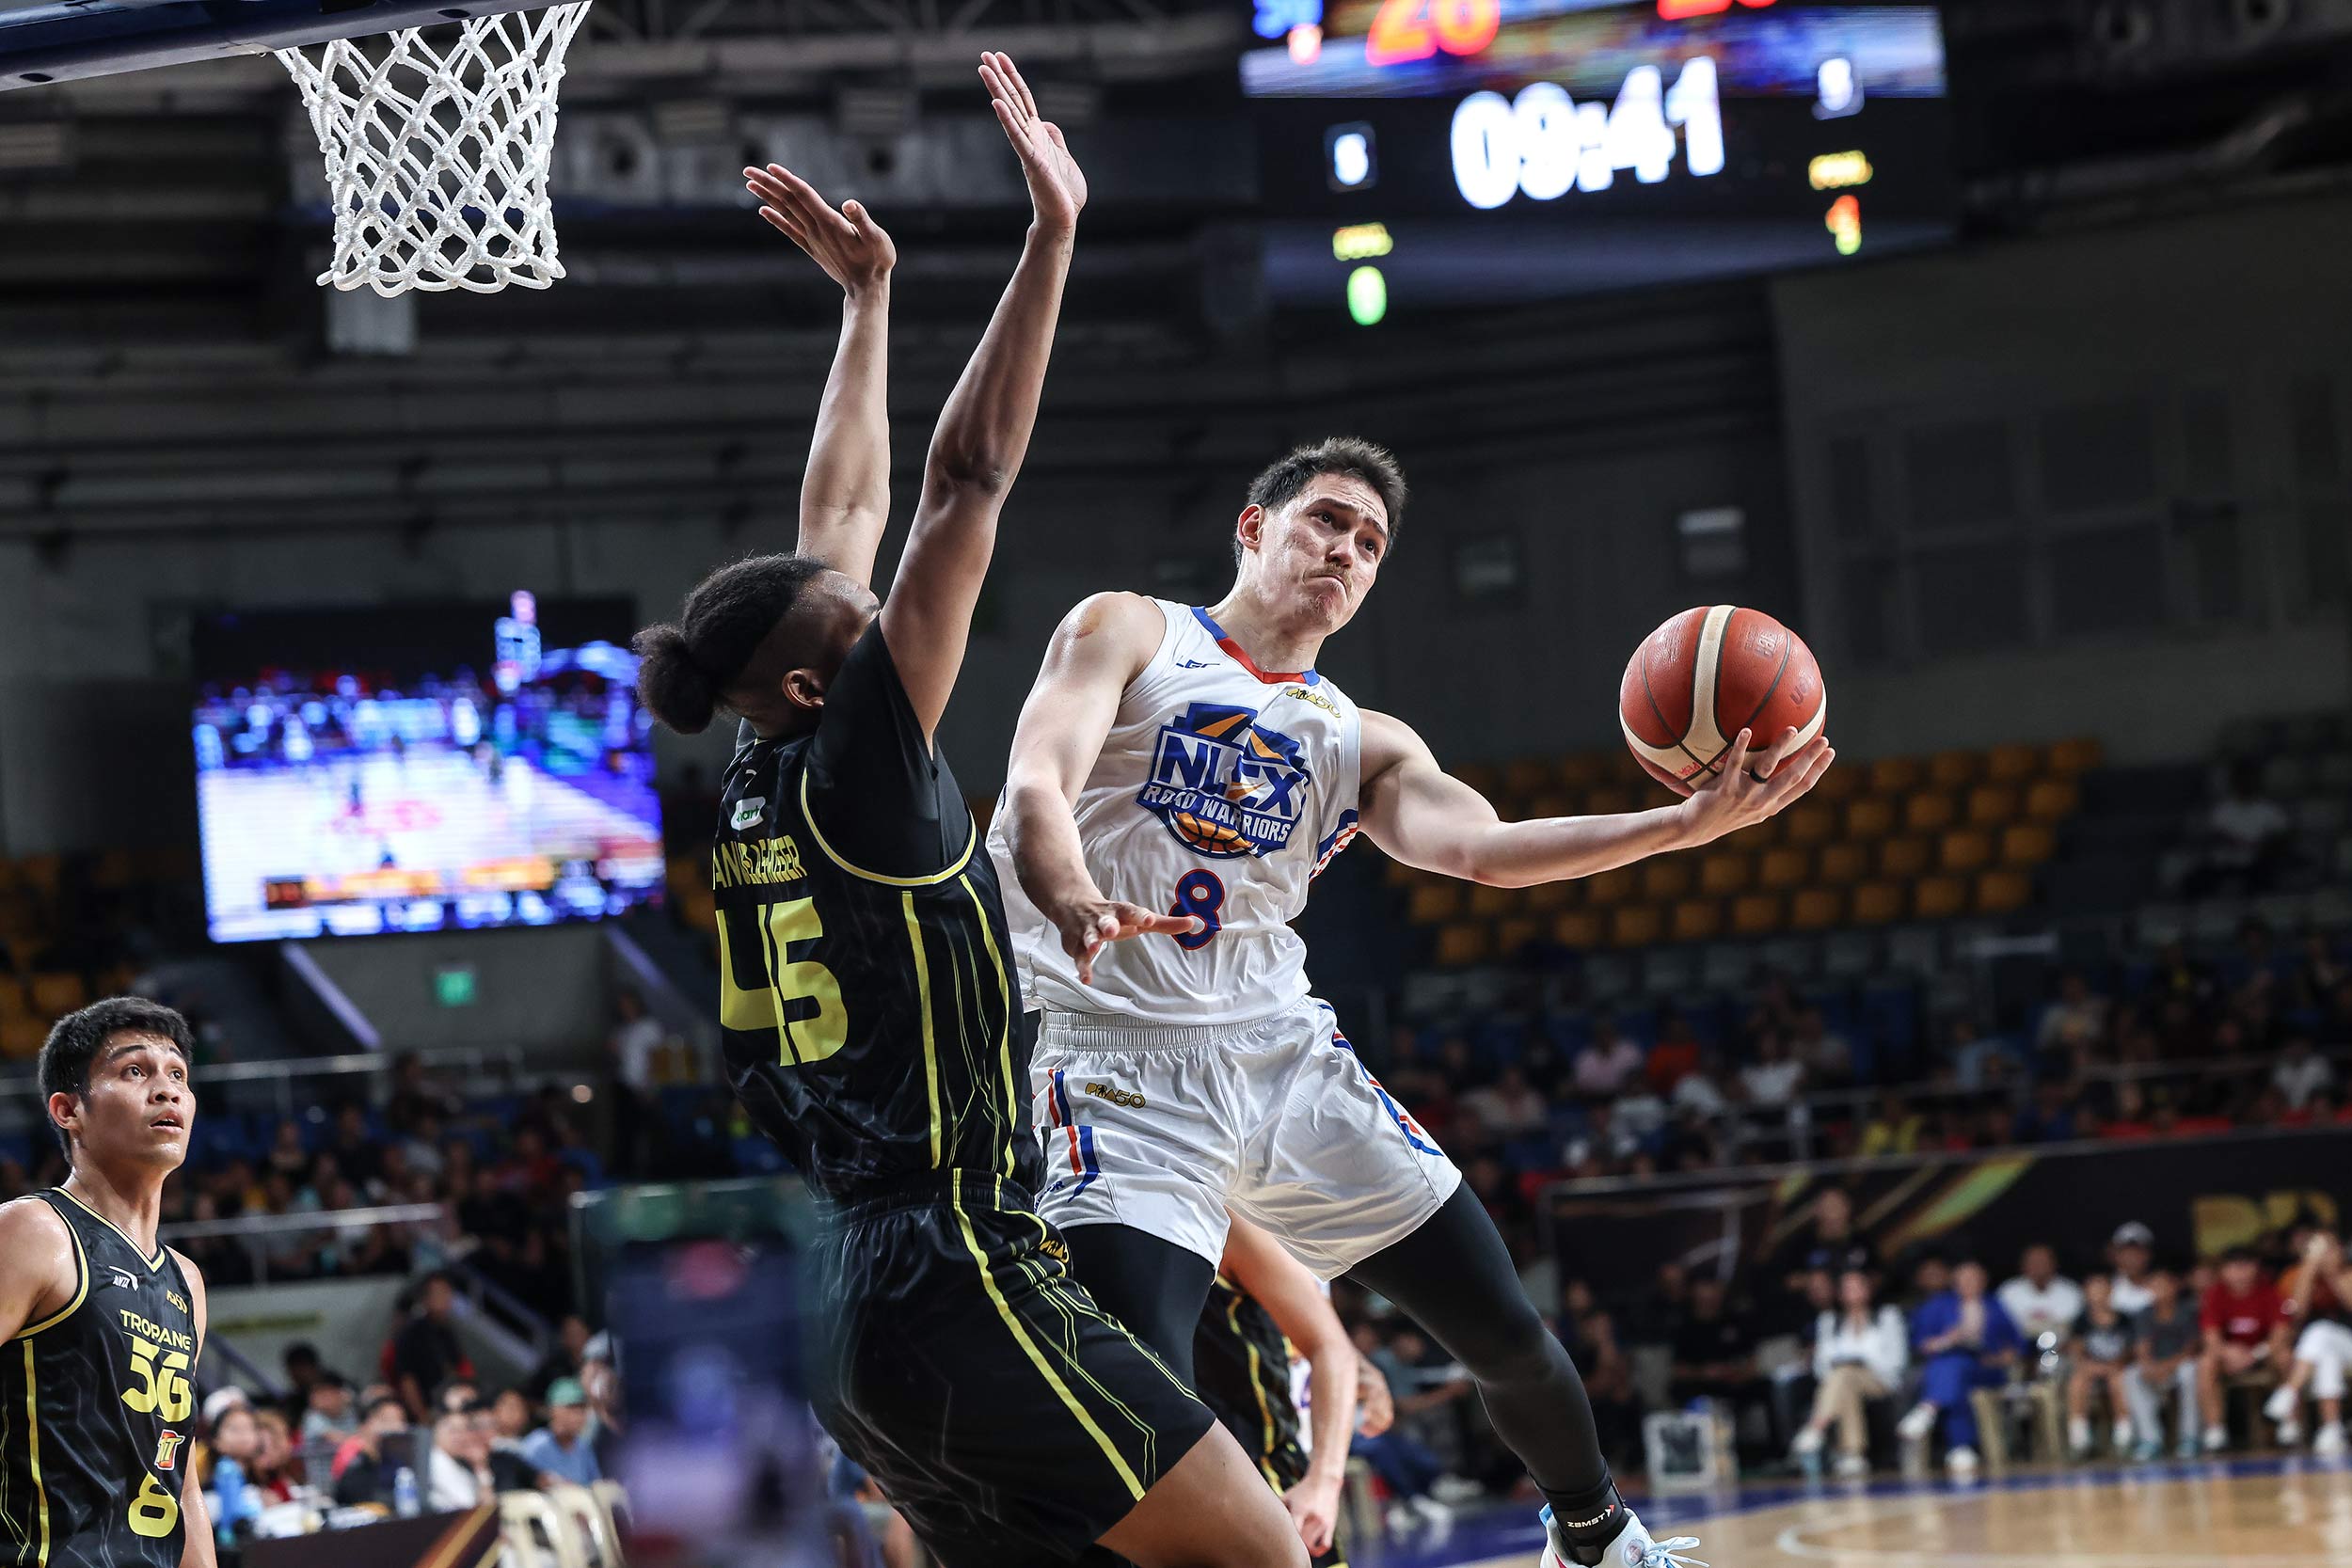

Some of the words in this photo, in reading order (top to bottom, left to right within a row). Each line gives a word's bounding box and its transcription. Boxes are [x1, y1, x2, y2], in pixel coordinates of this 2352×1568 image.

[1451, 56, 1725, 210] 09:41
[1157, 735, 1307, 818] NLEX
[1200, 799, 1293, 843] WARRIORS
[1168, 868, 1223, 951] 8
[715, 896, 848, 1067] 45
[119, 1308, 192, 1352] TROPANG
[120, 1331, 193, 1423] 5G
[127, 1470, 179, 1539] 8
